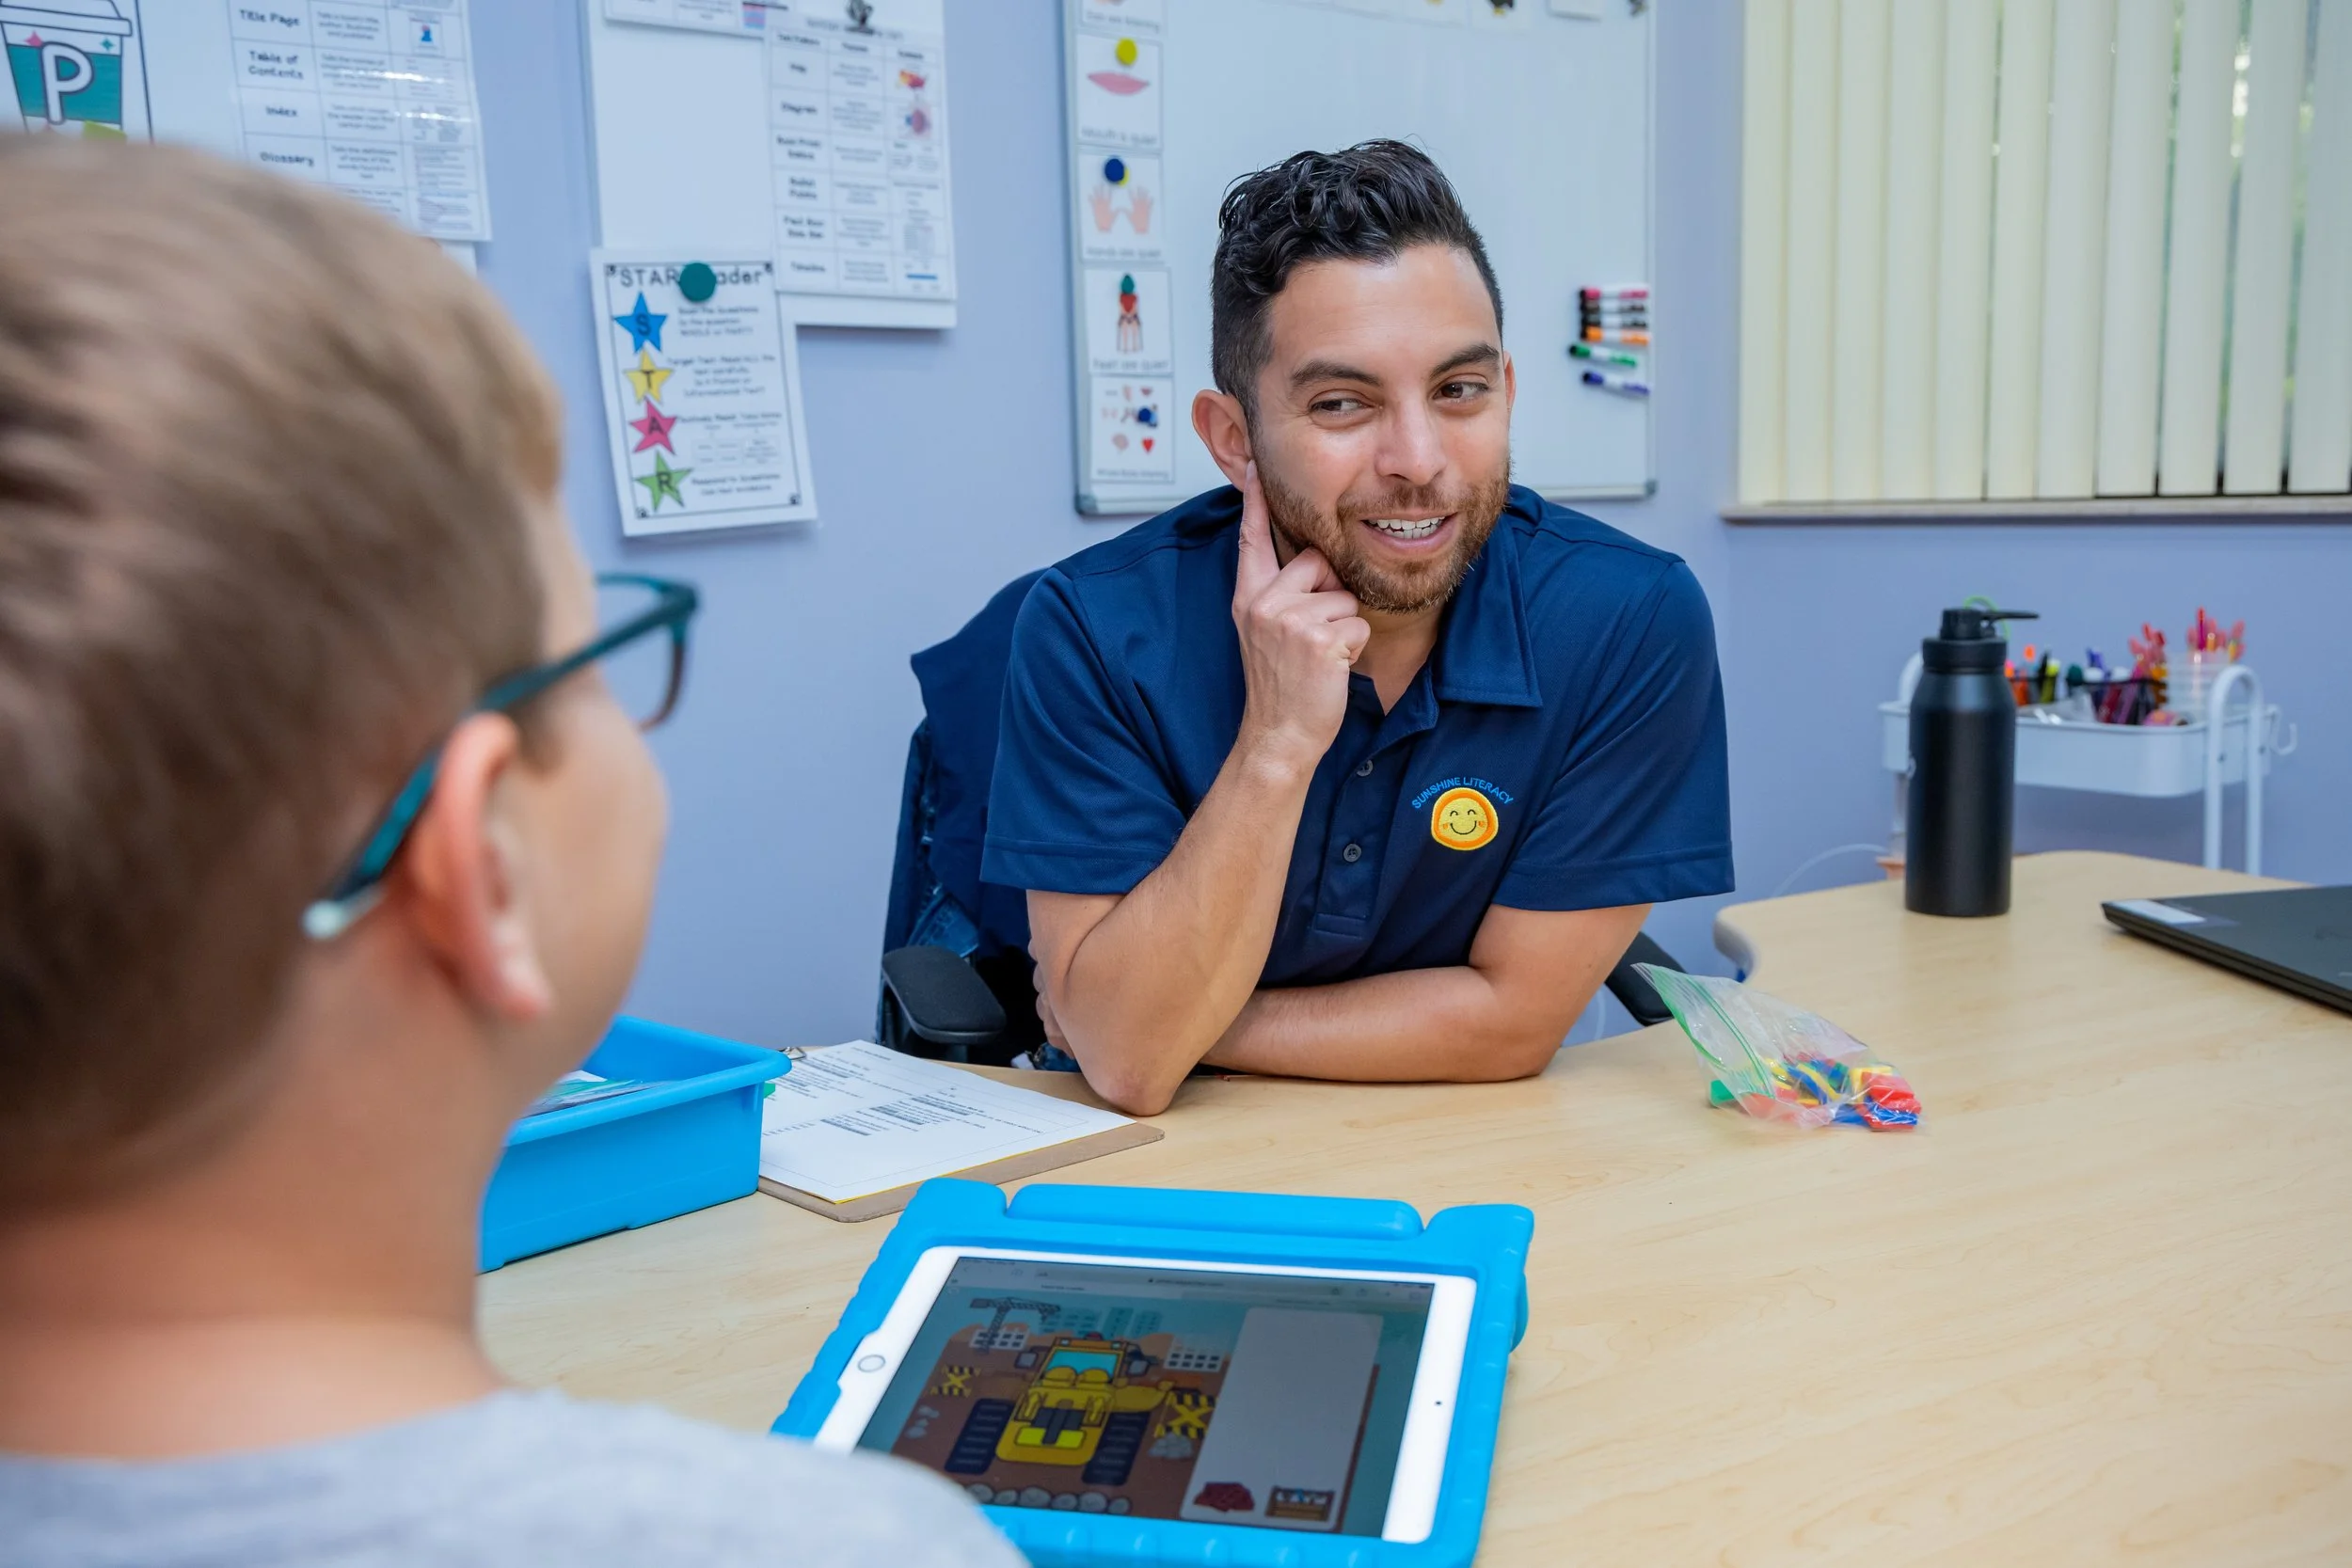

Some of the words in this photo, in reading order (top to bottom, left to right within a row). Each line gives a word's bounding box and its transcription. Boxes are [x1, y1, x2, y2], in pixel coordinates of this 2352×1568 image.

[269, 12, 300, 28] Page
[249, 50, 280, 63] Table
[286, 55, 298, 65] of
[248, 65, 304, 80] Contents
[40, 40, 96, 125] P
[265, 105, 297, 118] Index
[260, 151, 315, 167] Glossary
[620, 268, 679, 287] STAR
[635, 313, 652, 337] S
[640, 369, 655, 389] T
[648, 416, 664, 435] A
[657, 472, 674, 493] R
[1412, 777, 1460, 809] SUNSHINE
[1463, 776, 1514, 804] LITERACY
